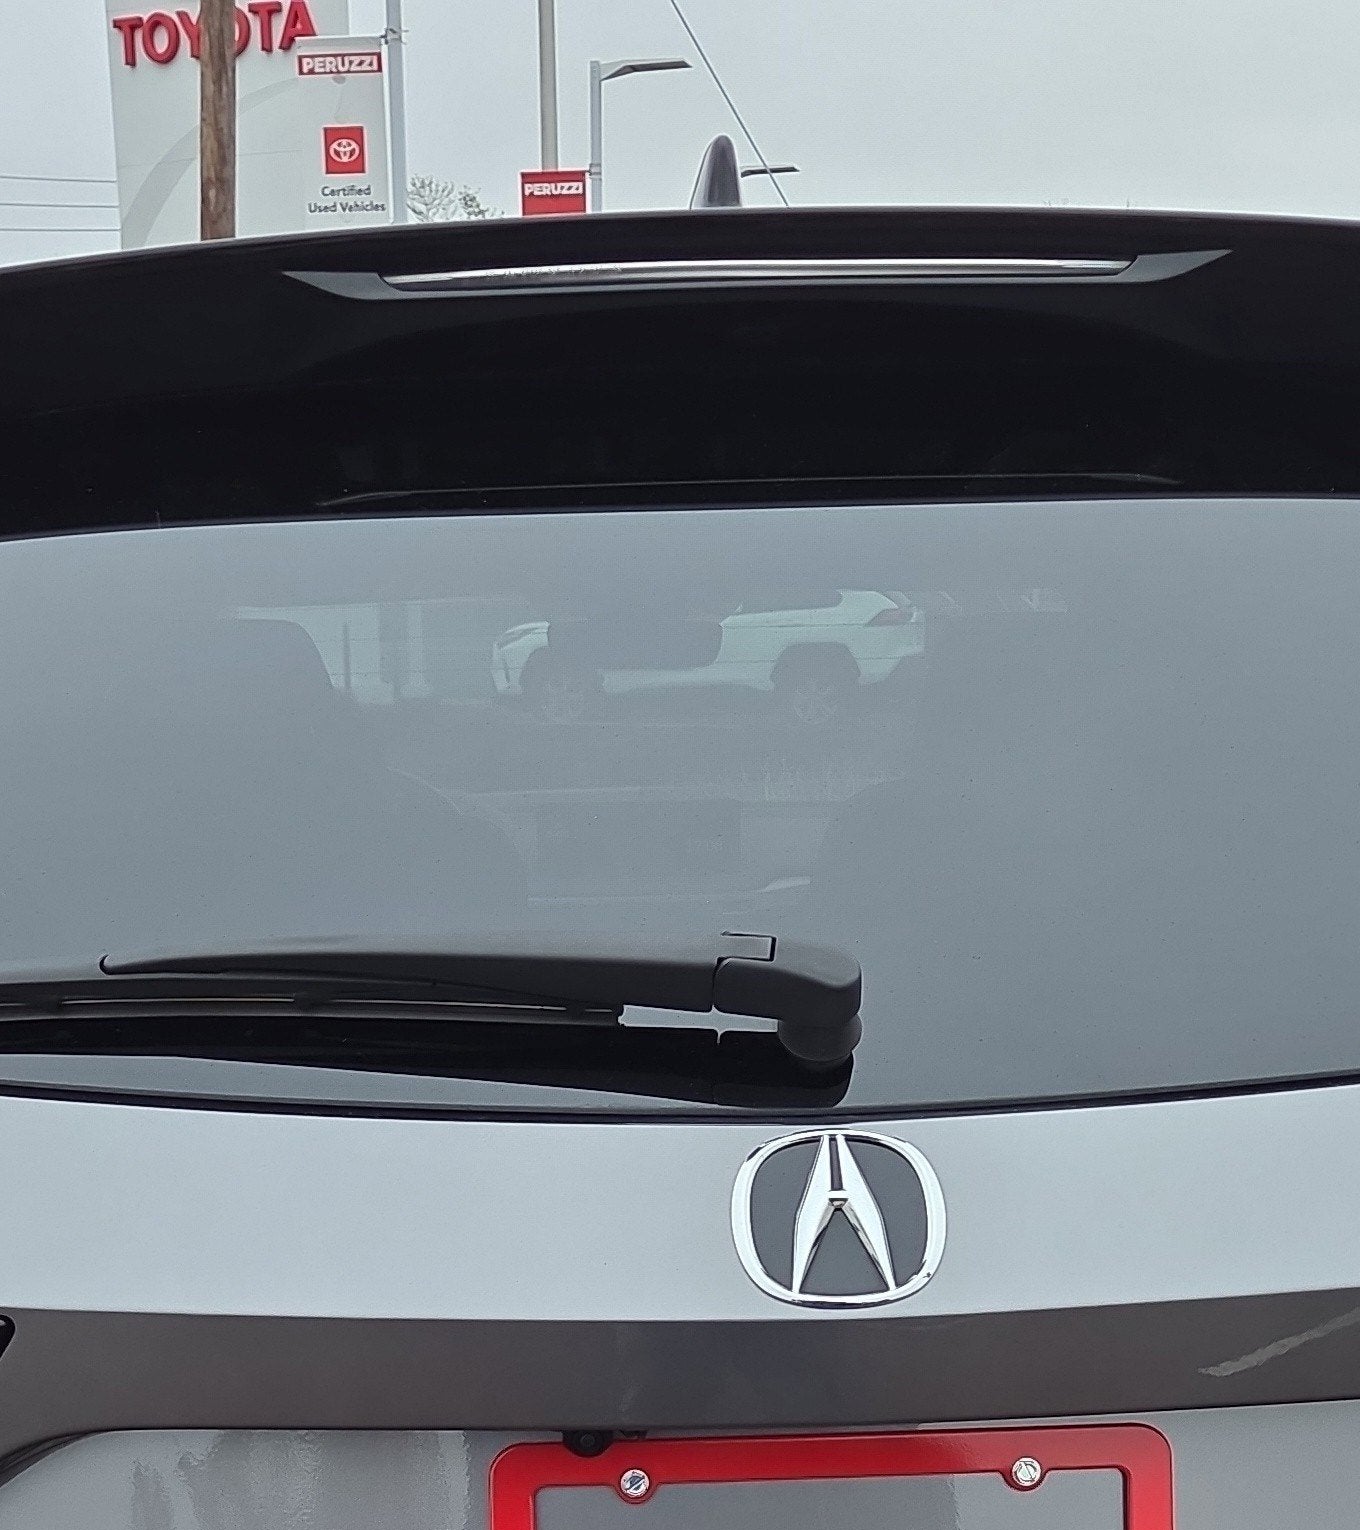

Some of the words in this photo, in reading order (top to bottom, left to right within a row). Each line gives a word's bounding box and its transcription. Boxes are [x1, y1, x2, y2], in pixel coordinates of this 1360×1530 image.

[302, 56, 378, 74] PERUZZI
[320, 185, 372, 197] Certified
[524, 182, 583, 196] PERUZZI
[308, 203, 337, 213] Used
[341, 202, 386, 213] Vehicles
